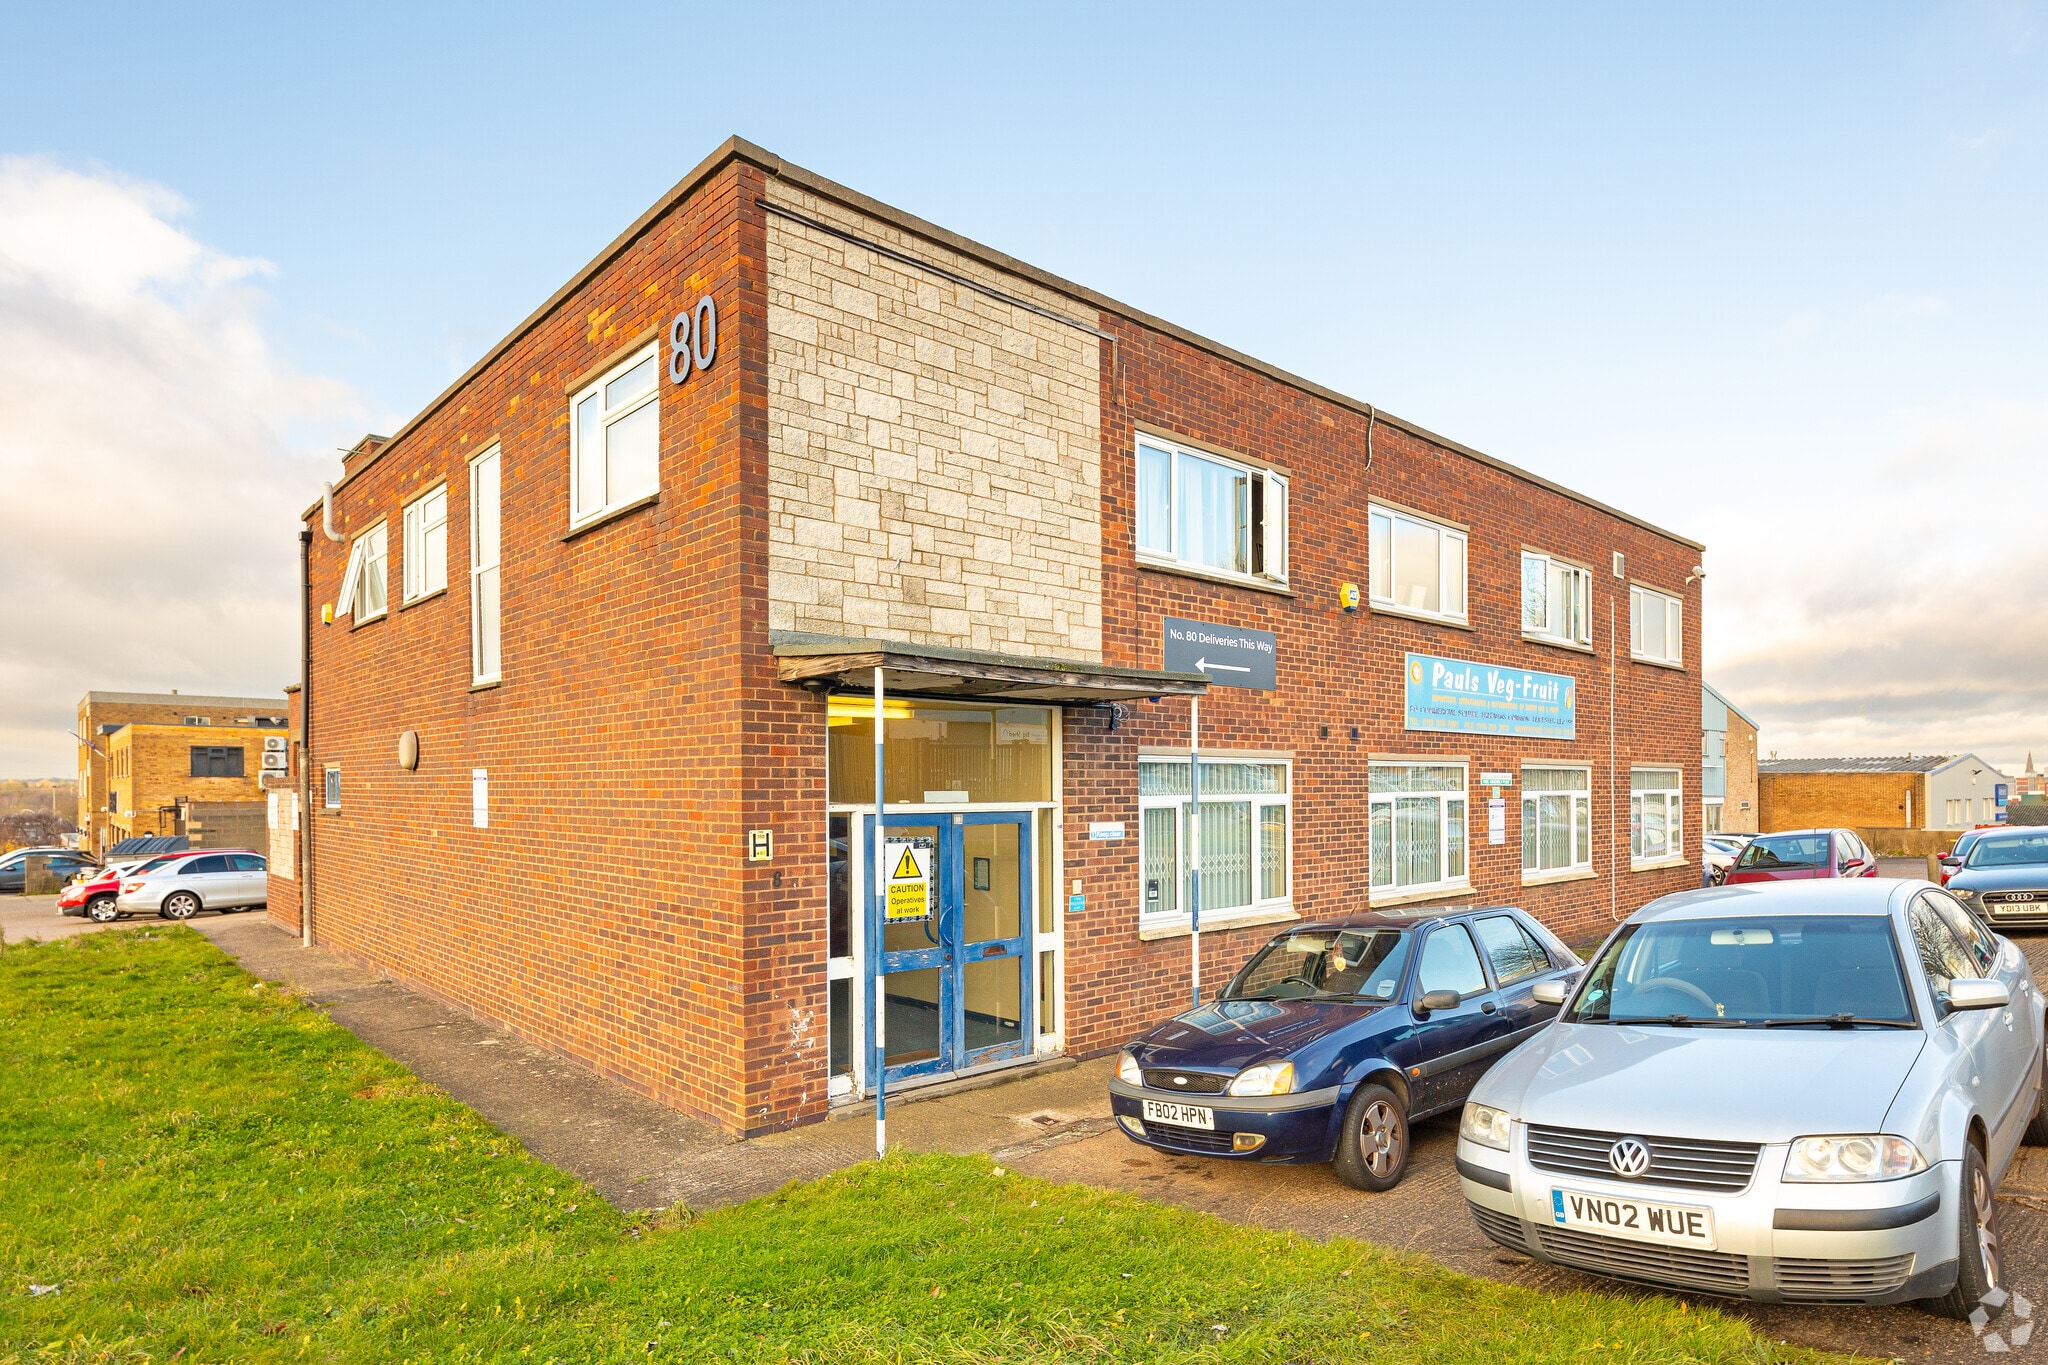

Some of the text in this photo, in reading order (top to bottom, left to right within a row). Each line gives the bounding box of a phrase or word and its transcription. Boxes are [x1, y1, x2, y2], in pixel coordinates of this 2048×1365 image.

[669, 294, 716, 385] 80
[1170, 628, 1273, 654] No. 80 Deliveries This Way
[1432, 661, 1559, 702] Pauls Veg-Fruit
[753, 833, 769, 857] H
[890, 884, 924, 894] CAUTION
[890, 896, 925, 906] Operatives
[1999, 904, 2041, 913] YD13 UBK
[1147, 1101, 1207, 1124] FB02 HPN
[1570, 1195, 1706, 1238] VN02 WUE
